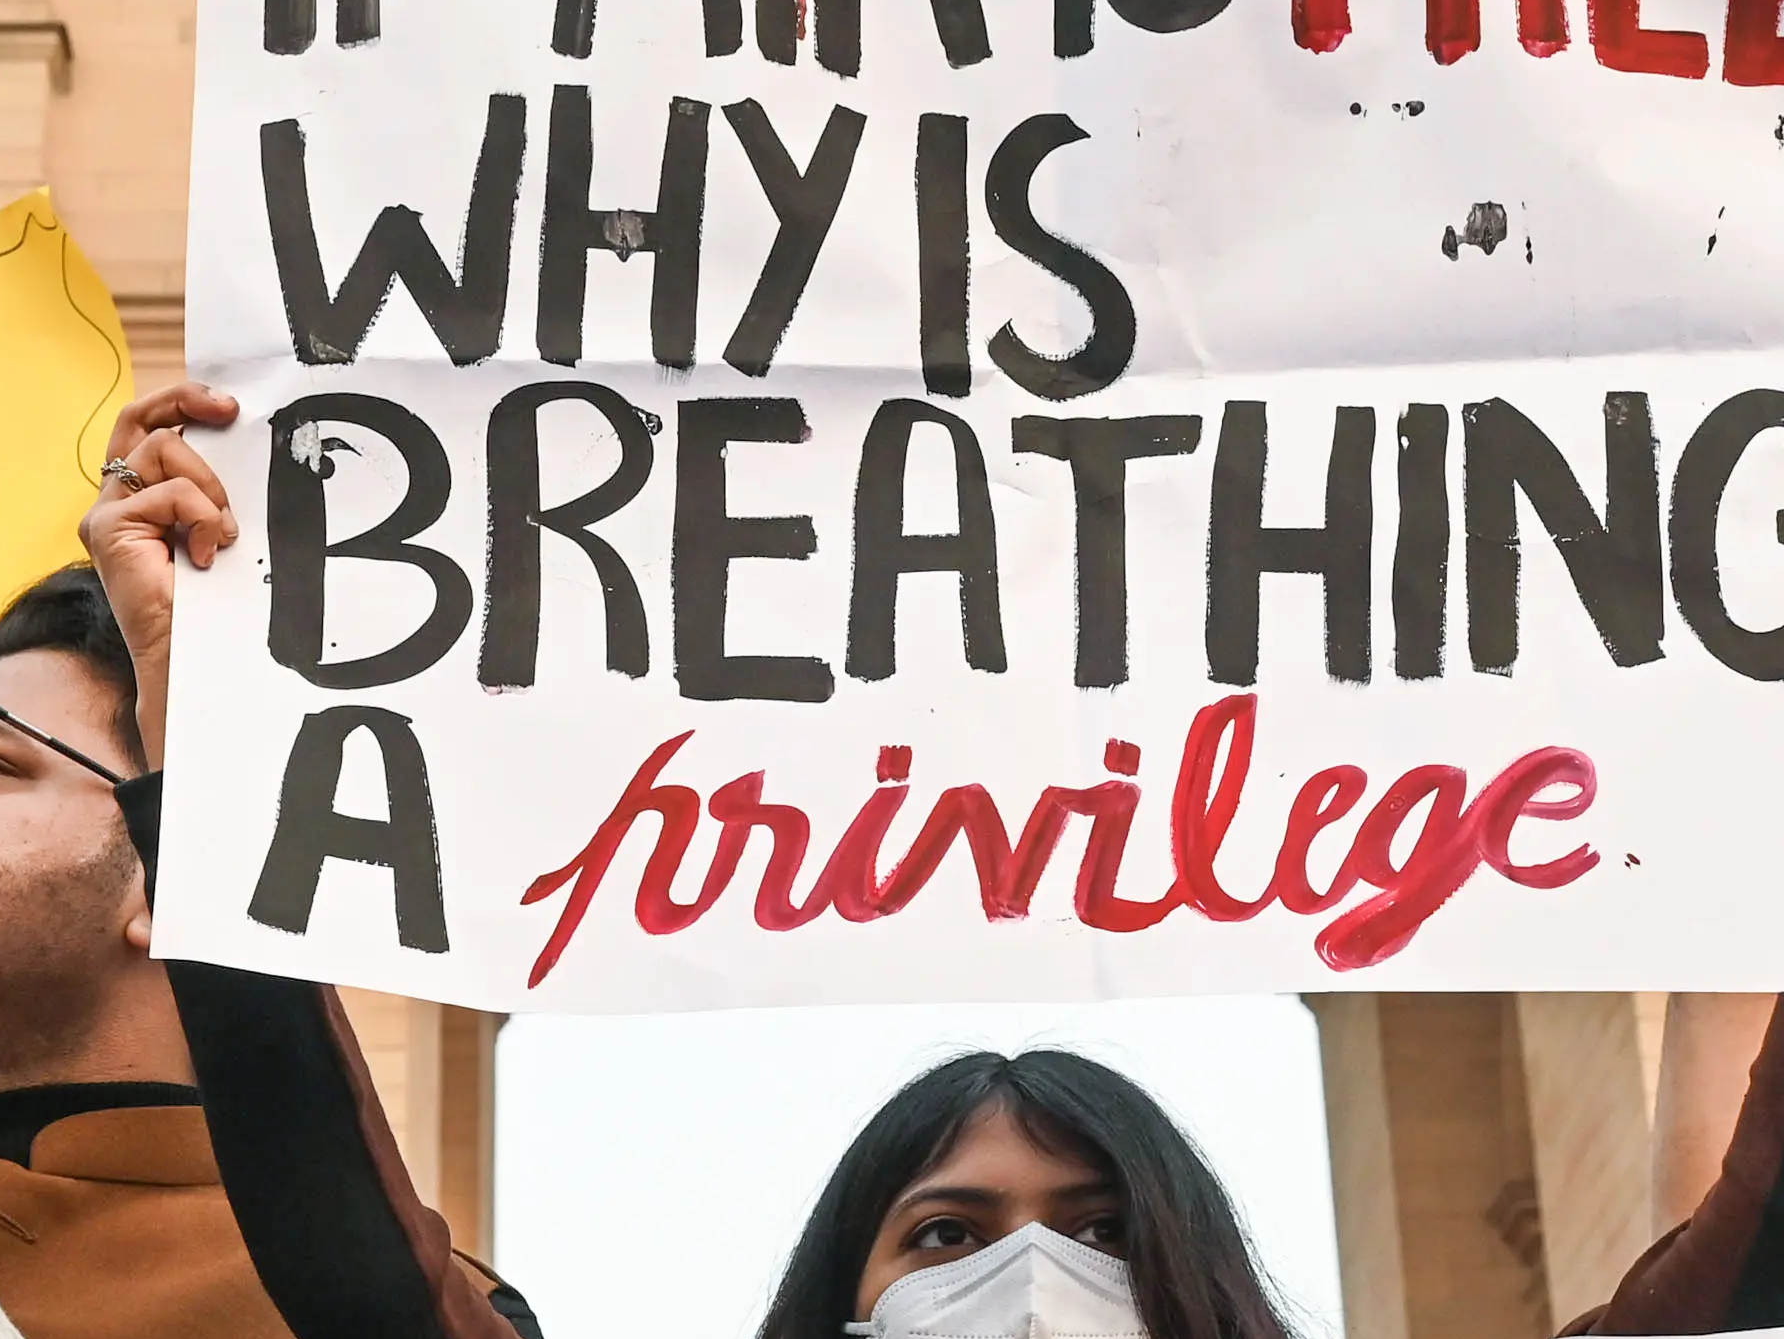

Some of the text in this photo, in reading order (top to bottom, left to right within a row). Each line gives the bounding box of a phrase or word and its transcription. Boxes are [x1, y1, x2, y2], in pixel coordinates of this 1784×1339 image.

[260, 84, 1136, 398] WHY IS
[247, 692, 1602, 990] A privilege
